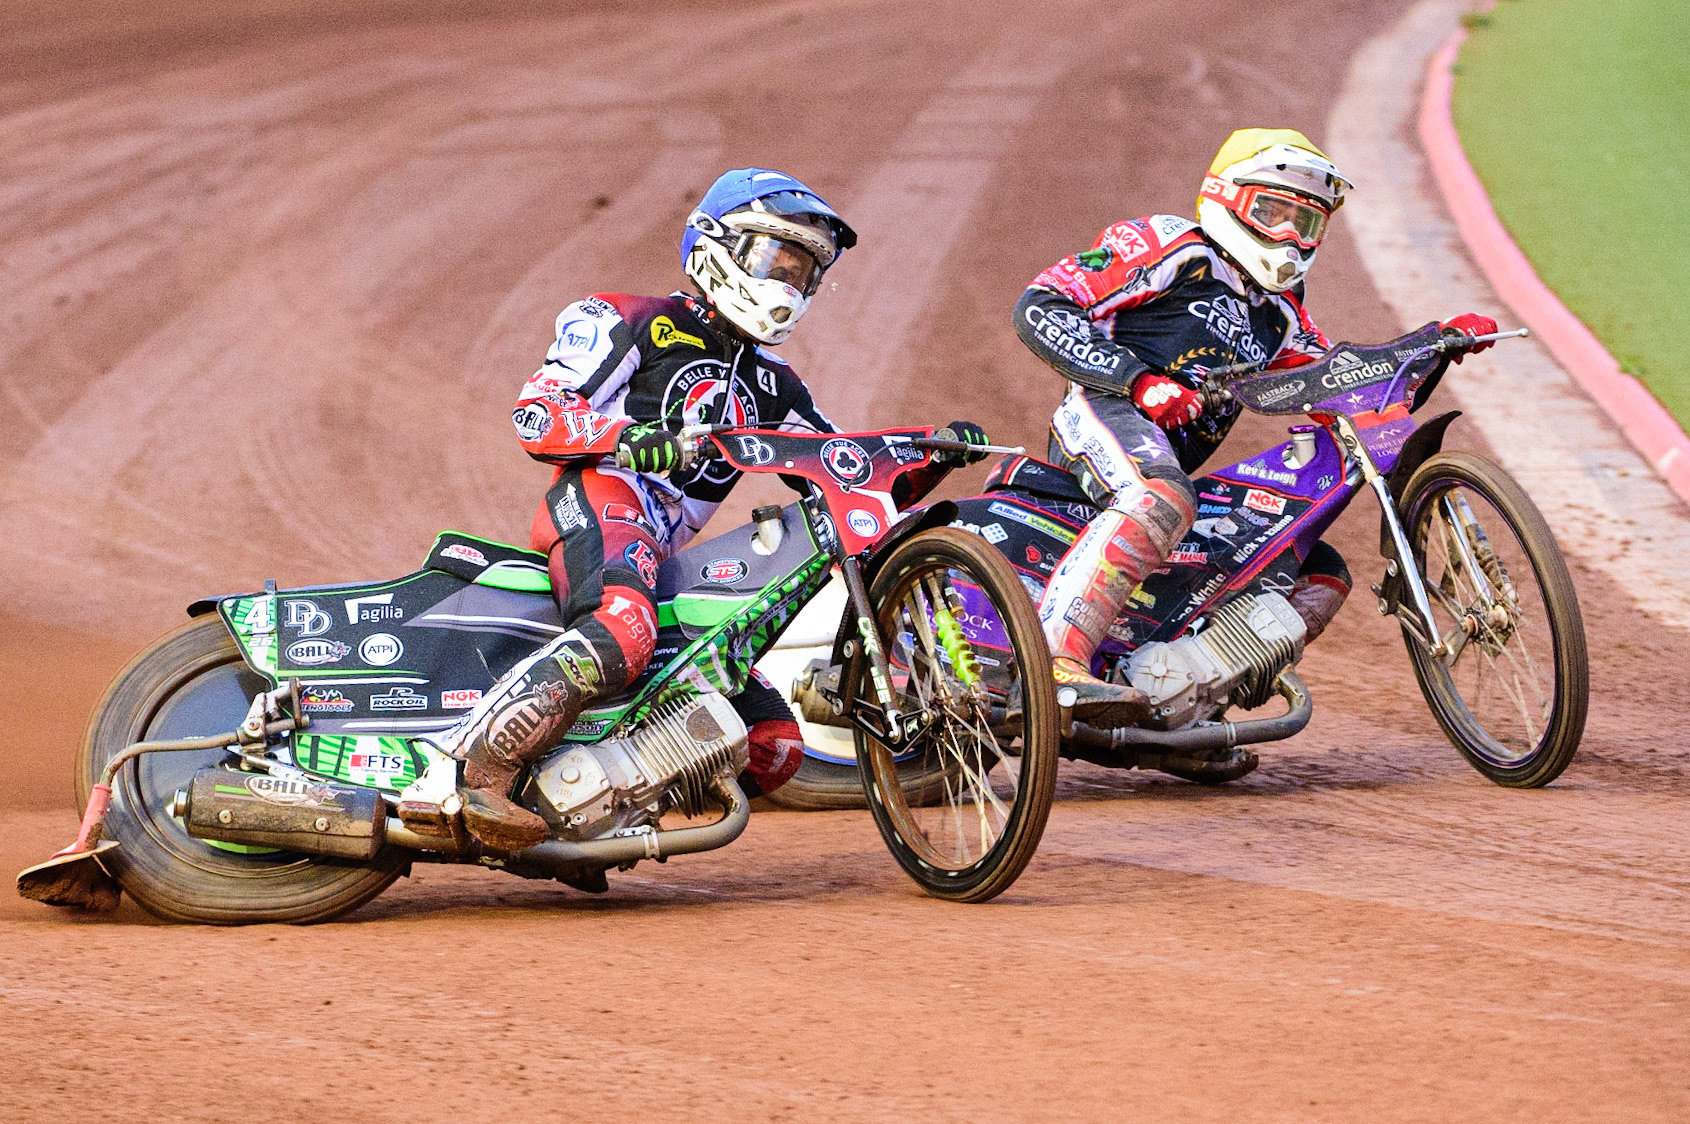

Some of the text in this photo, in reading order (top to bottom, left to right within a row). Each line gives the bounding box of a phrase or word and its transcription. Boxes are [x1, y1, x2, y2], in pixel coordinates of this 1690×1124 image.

[1025, 305, 1120, 369] Crendon
[1033, 330, 1058, 353] TIMBER
[677, 367, 714, 391] BELLE
[761, 370, 773, 394] 4
[1321, 361, 1395, 389] Crendon
[1257, 382, 1295, 402] FASTRACK
[896, 443, 924, 461] agilia
[1237, 463, 1297, 487] Kev & Leigh
[1248, 492, 1283, 509] NGK
[853, 519, 873, 527] ATPI
[995, 505, 1075, 541] Allied Vehicles
[1232, 541, 1259, 564] Nick
[708, 565, 741, 576] STS
[1189, 573, 1227, 606] White
[243, 599, 272, 628] 4
[361, 606, 404, 623] agilia
[367, 645, 393, 655] ATPI
[405, 698, 425, 706] OIL
[443, 691, 480, 701] NGK
[368, 755, 402, 769] FTS
